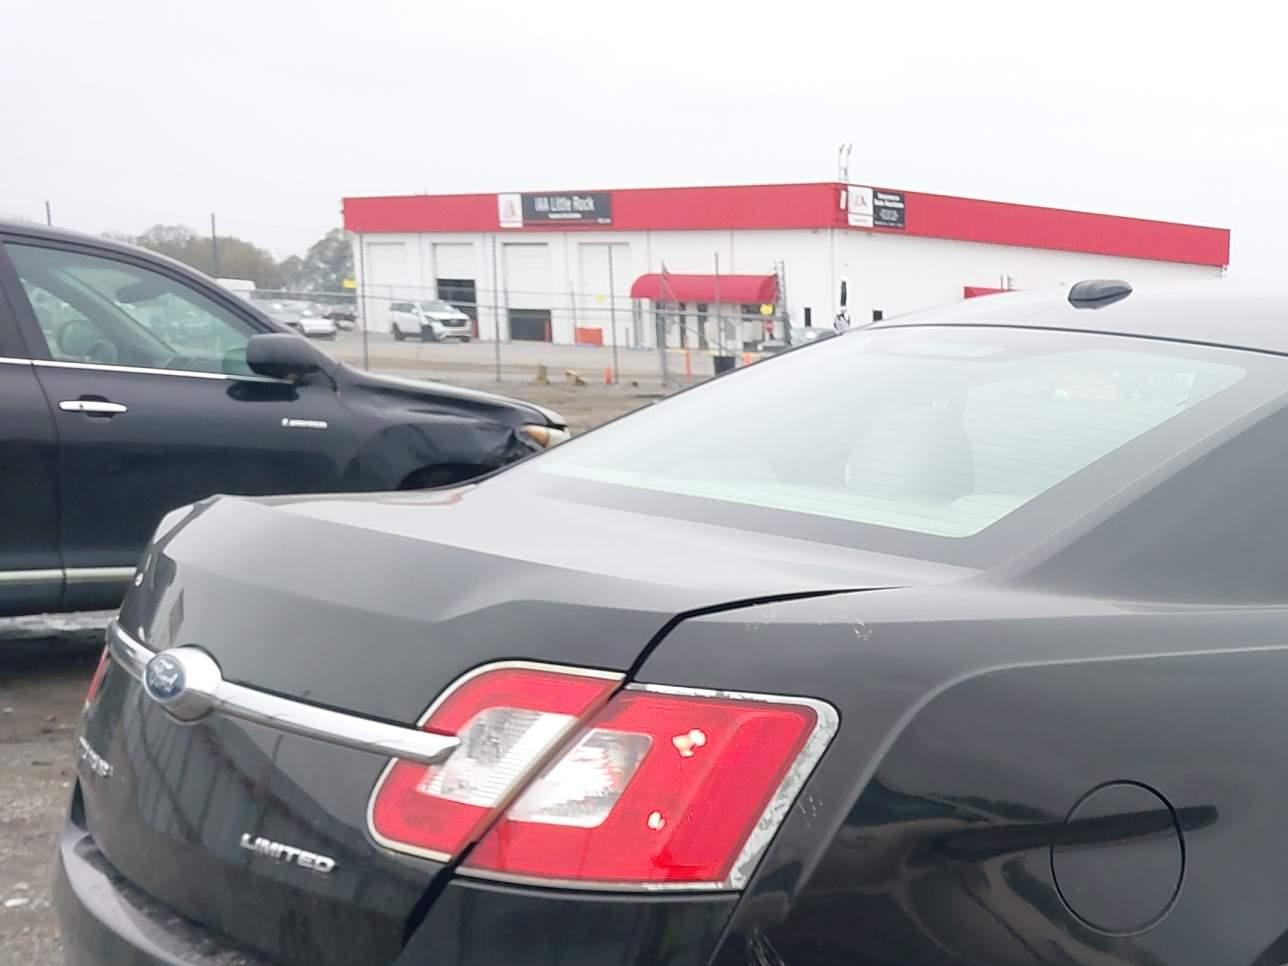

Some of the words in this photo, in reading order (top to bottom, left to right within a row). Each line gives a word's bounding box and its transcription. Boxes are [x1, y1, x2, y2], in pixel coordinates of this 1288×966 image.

[551, 196, 572, 211] Little
[572, 195, 595, 211] Rock
[239, 832, 337, 872] LIMITED
